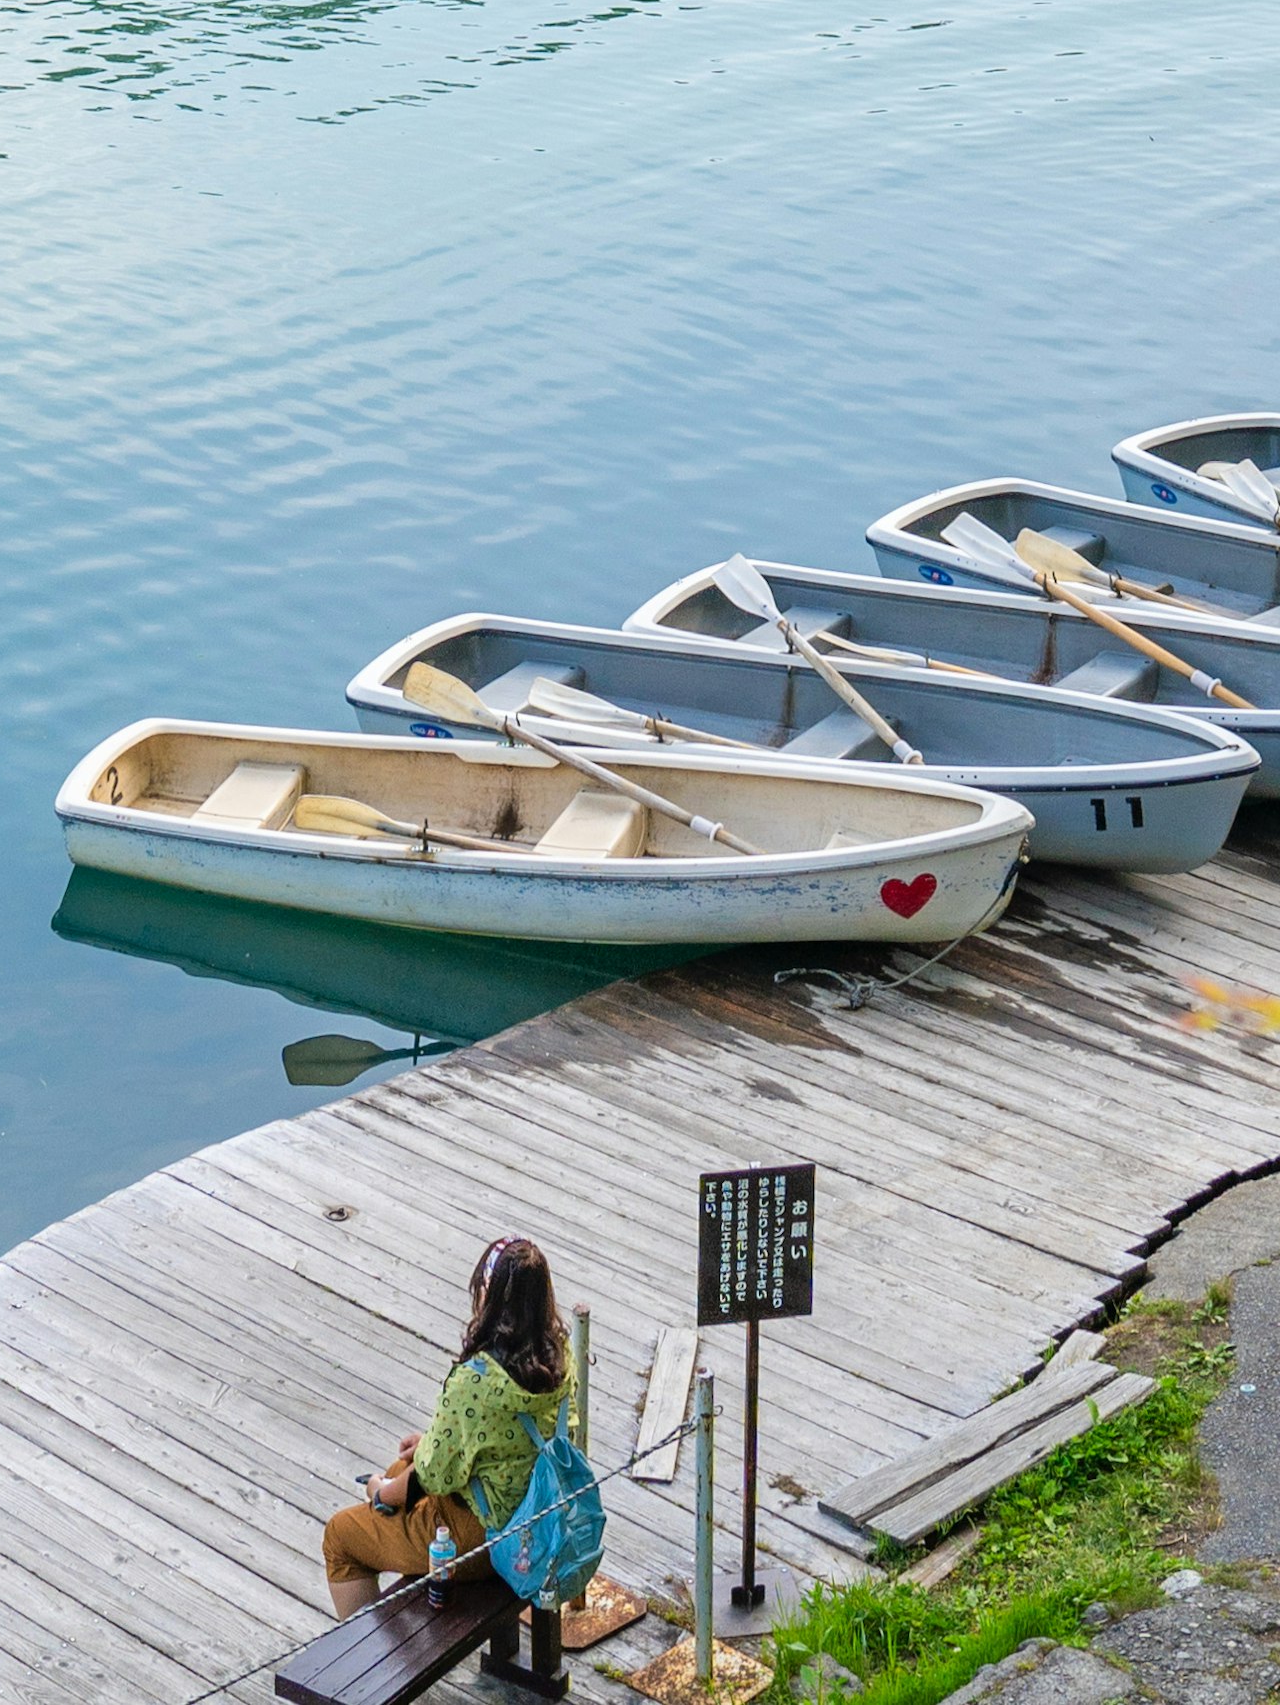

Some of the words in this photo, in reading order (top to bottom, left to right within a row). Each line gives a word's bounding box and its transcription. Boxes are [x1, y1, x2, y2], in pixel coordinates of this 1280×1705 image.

[1090, 796, 1144, 831] 11
[790, 1199, 809, 1260] お願い
